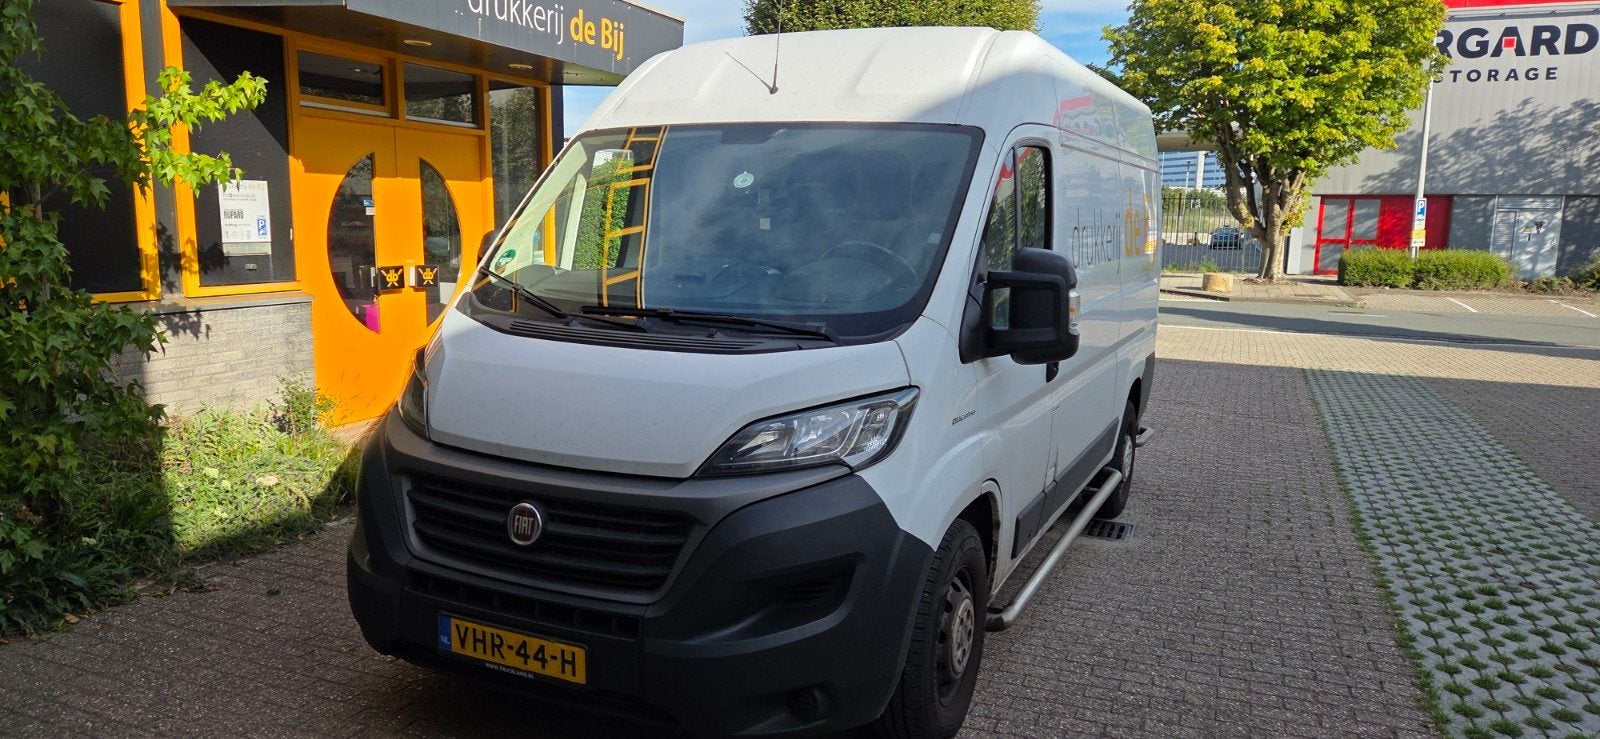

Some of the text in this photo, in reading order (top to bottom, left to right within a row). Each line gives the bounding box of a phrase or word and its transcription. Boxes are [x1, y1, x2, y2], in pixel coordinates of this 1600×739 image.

[569, 8, 596, 45] de
[601, 17, 625, 61] Bij
[1072, 207, 1121, 274] drukkerij
[1125, 187, 1140, 257] de
[513, 514, 535, 536] FIAT
[440, 635, 451, 645] NL
[454, 622, 577, 678] VHR-44-H
